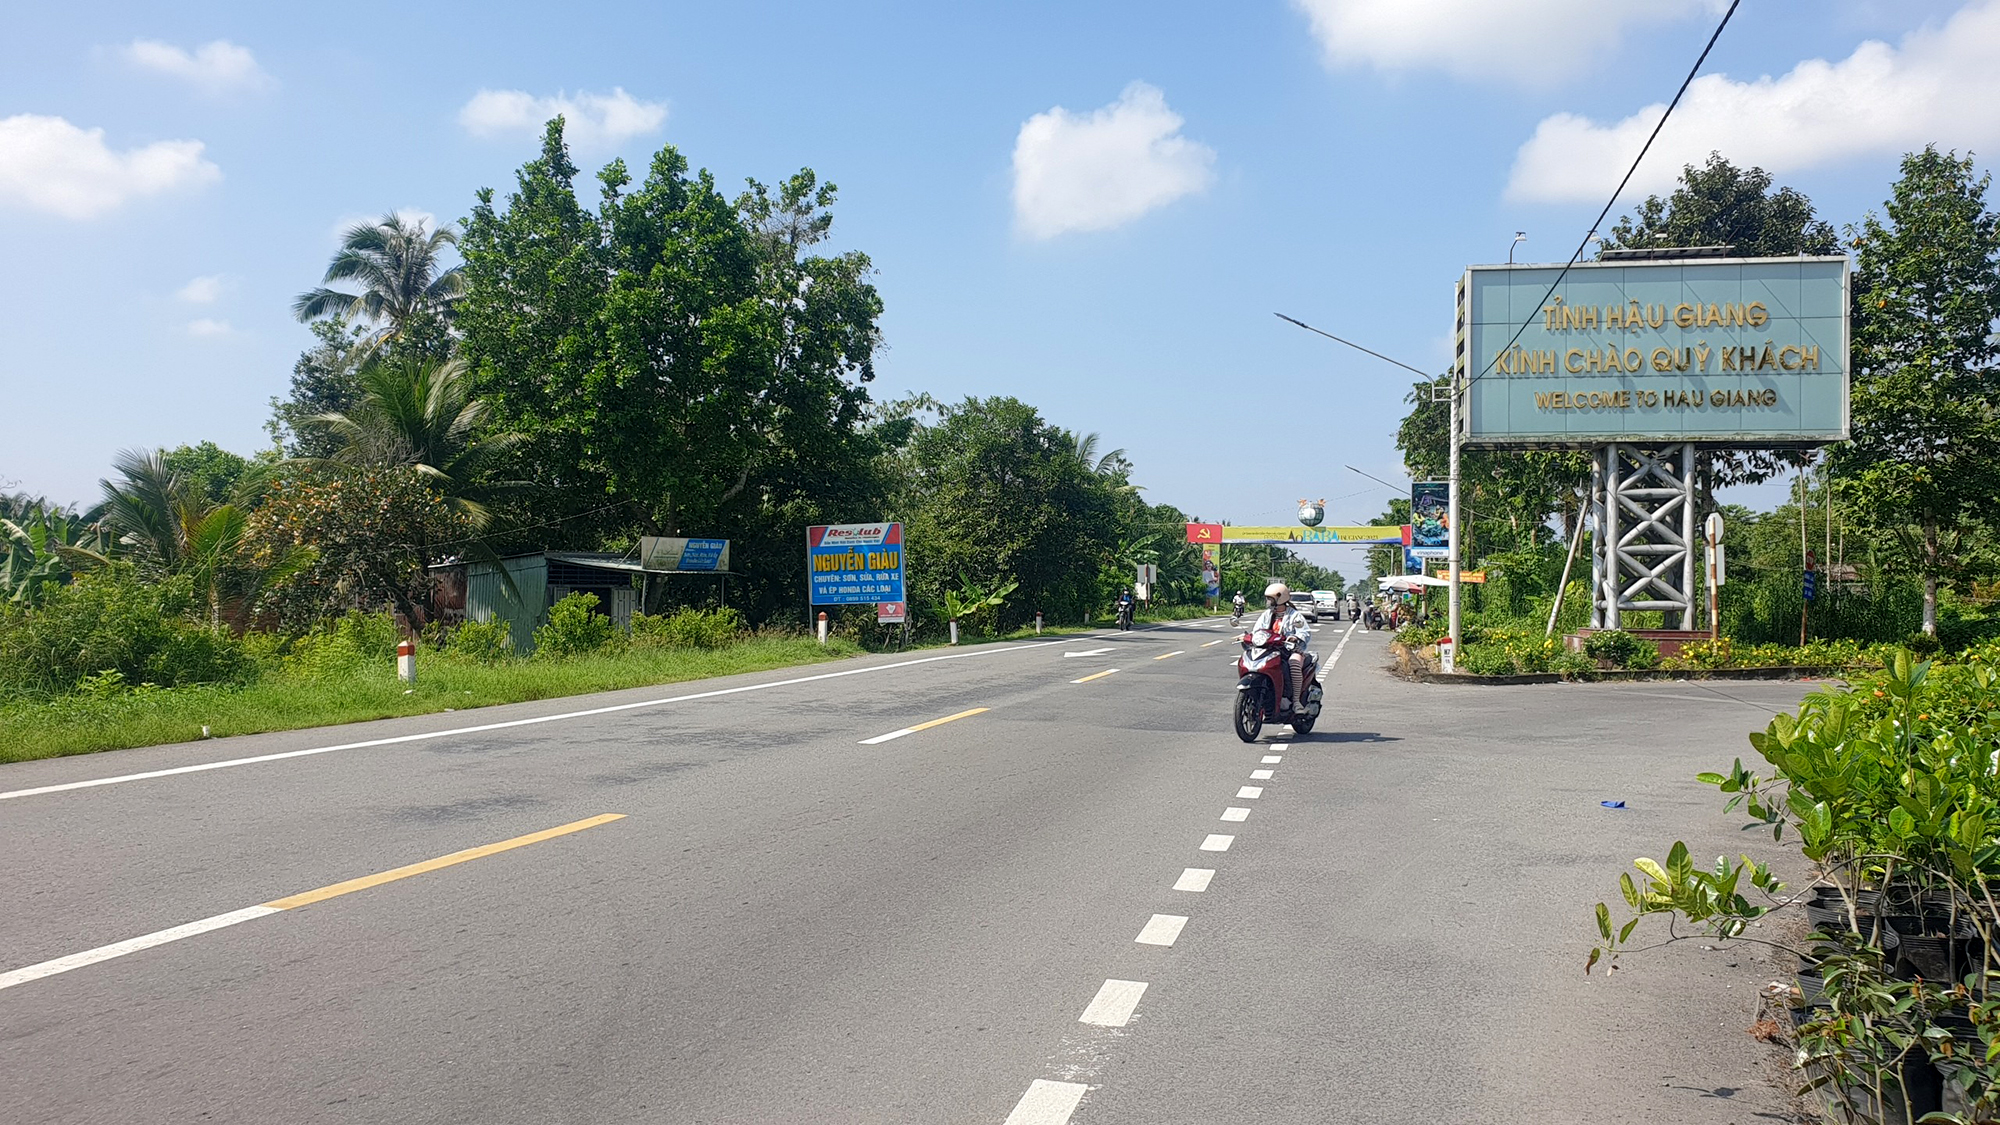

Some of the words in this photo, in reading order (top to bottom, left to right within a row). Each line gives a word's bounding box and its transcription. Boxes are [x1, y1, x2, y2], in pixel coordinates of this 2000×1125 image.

[1543, 295, 1598, 330] TỈNH
[1606, 297, 1664, 334] HẬU
[1673, 301, 1768, 328] GIANG
[1495, 343, 1555, 374] KÍNH
[1564, 342, 1642, 373] CHÀO
[1651, 339, 1711, 372] QUÝ
[1722, 338, 1819, 372] KHÁCH
[1534, 390, 1630, 409] WELCOME
[1635, 390, 1658, 408] TO
[1664, 390, 1703, 407] HAU
[1710, 388, 1777, 407] GIANG
[813, 546, 865, 572] NGUYỄN
[868, 548, 899, 571] GIÀU
[890, 572, 899, 581] XE
[838, 585, 860, 593] HONDA
[862, 584, 875, 593] CÁC
